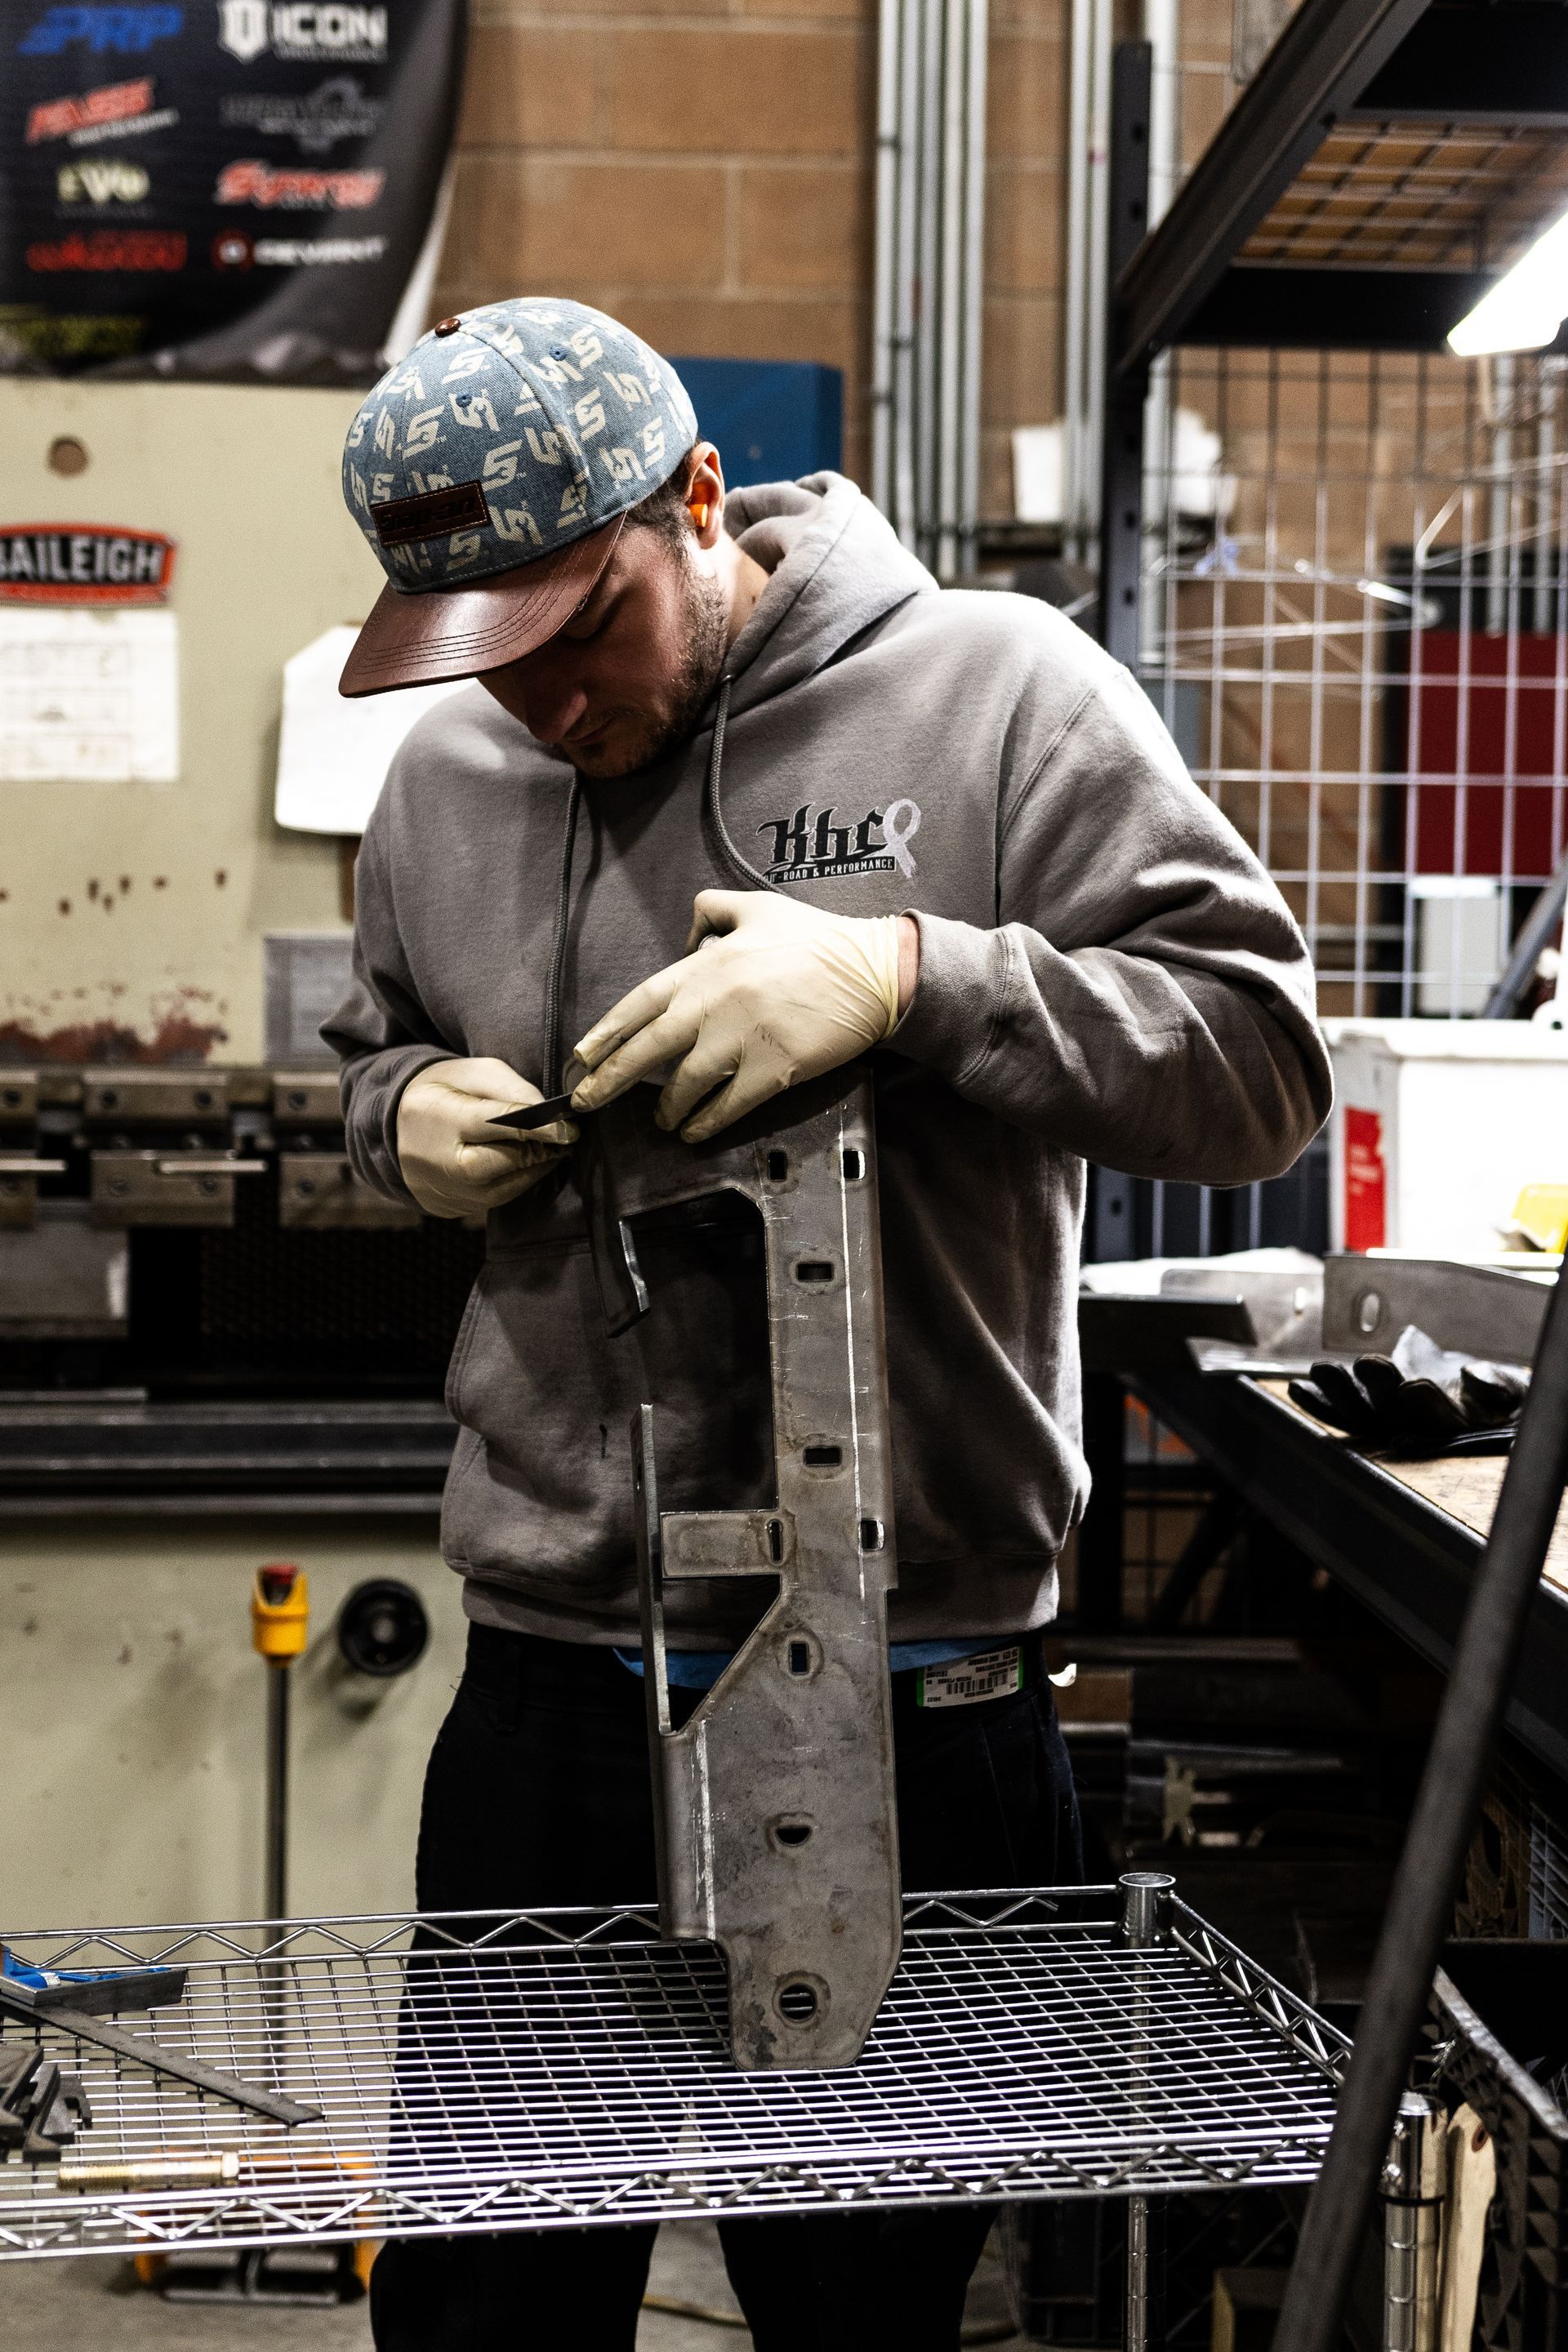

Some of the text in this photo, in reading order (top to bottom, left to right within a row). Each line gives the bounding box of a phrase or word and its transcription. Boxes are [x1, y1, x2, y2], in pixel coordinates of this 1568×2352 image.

[274, 5, 387, 47] ICON
[813, 867, 820, 877] &
[824, 858, 893, 875] PERFORMANCE
